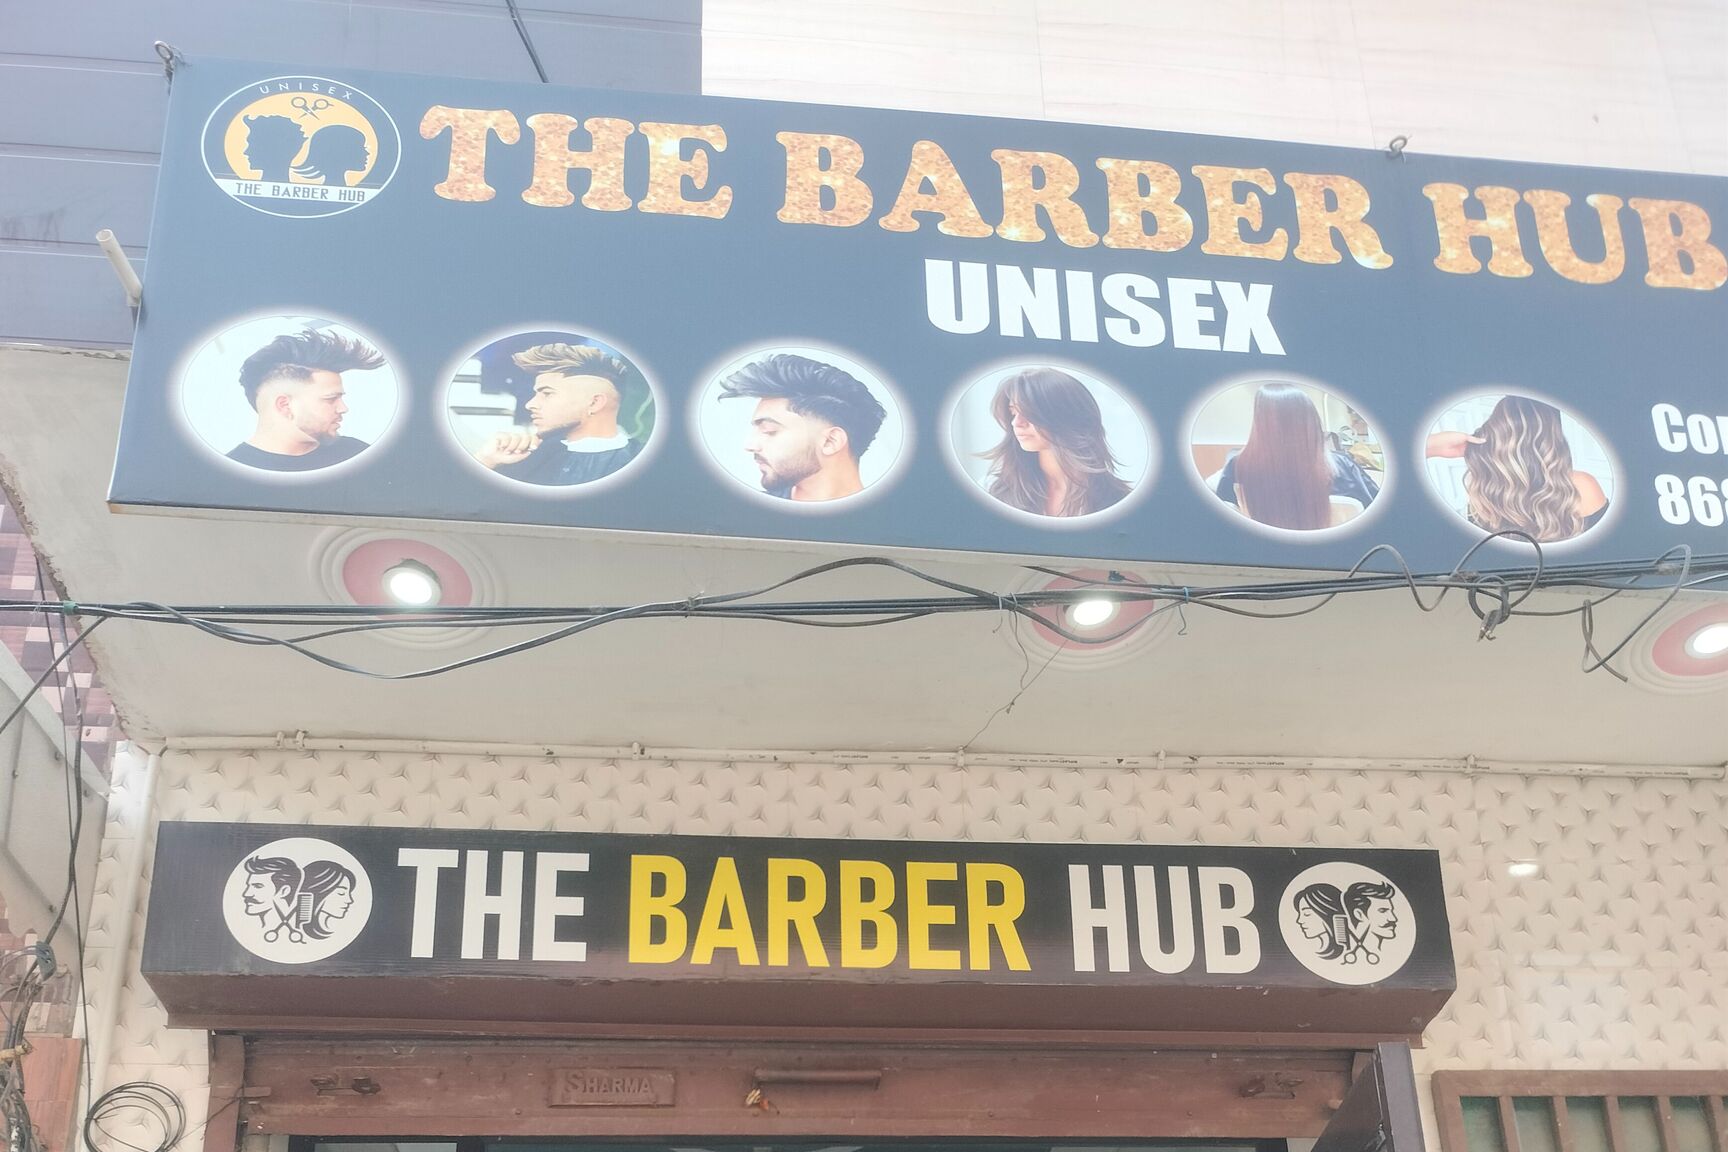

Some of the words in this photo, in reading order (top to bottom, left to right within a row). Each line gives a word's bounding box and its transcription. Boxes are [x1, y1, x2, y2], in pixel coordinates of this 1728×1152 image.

[259, 82, 353, 100] UNISEX
[235, 182, 262, 196] THE
[271, 185, 329, 200] BARBER
[338, 189, 366, 202] HUB
[419, 104, 733, 219] THE
[775, 131, 1394, 270] BARBER
[1422, 182, 1728, 291] HUB
[924, 258, 1287, 356] UNISEX
[1654, 473, 1728, 527] 86
[397, 848, 590, 962] THE
[628, 854, 1032, 972] BARBER
[1068, 864, 1262, 974] HUB
[564, 1070, 654, 1094] SHARMA
